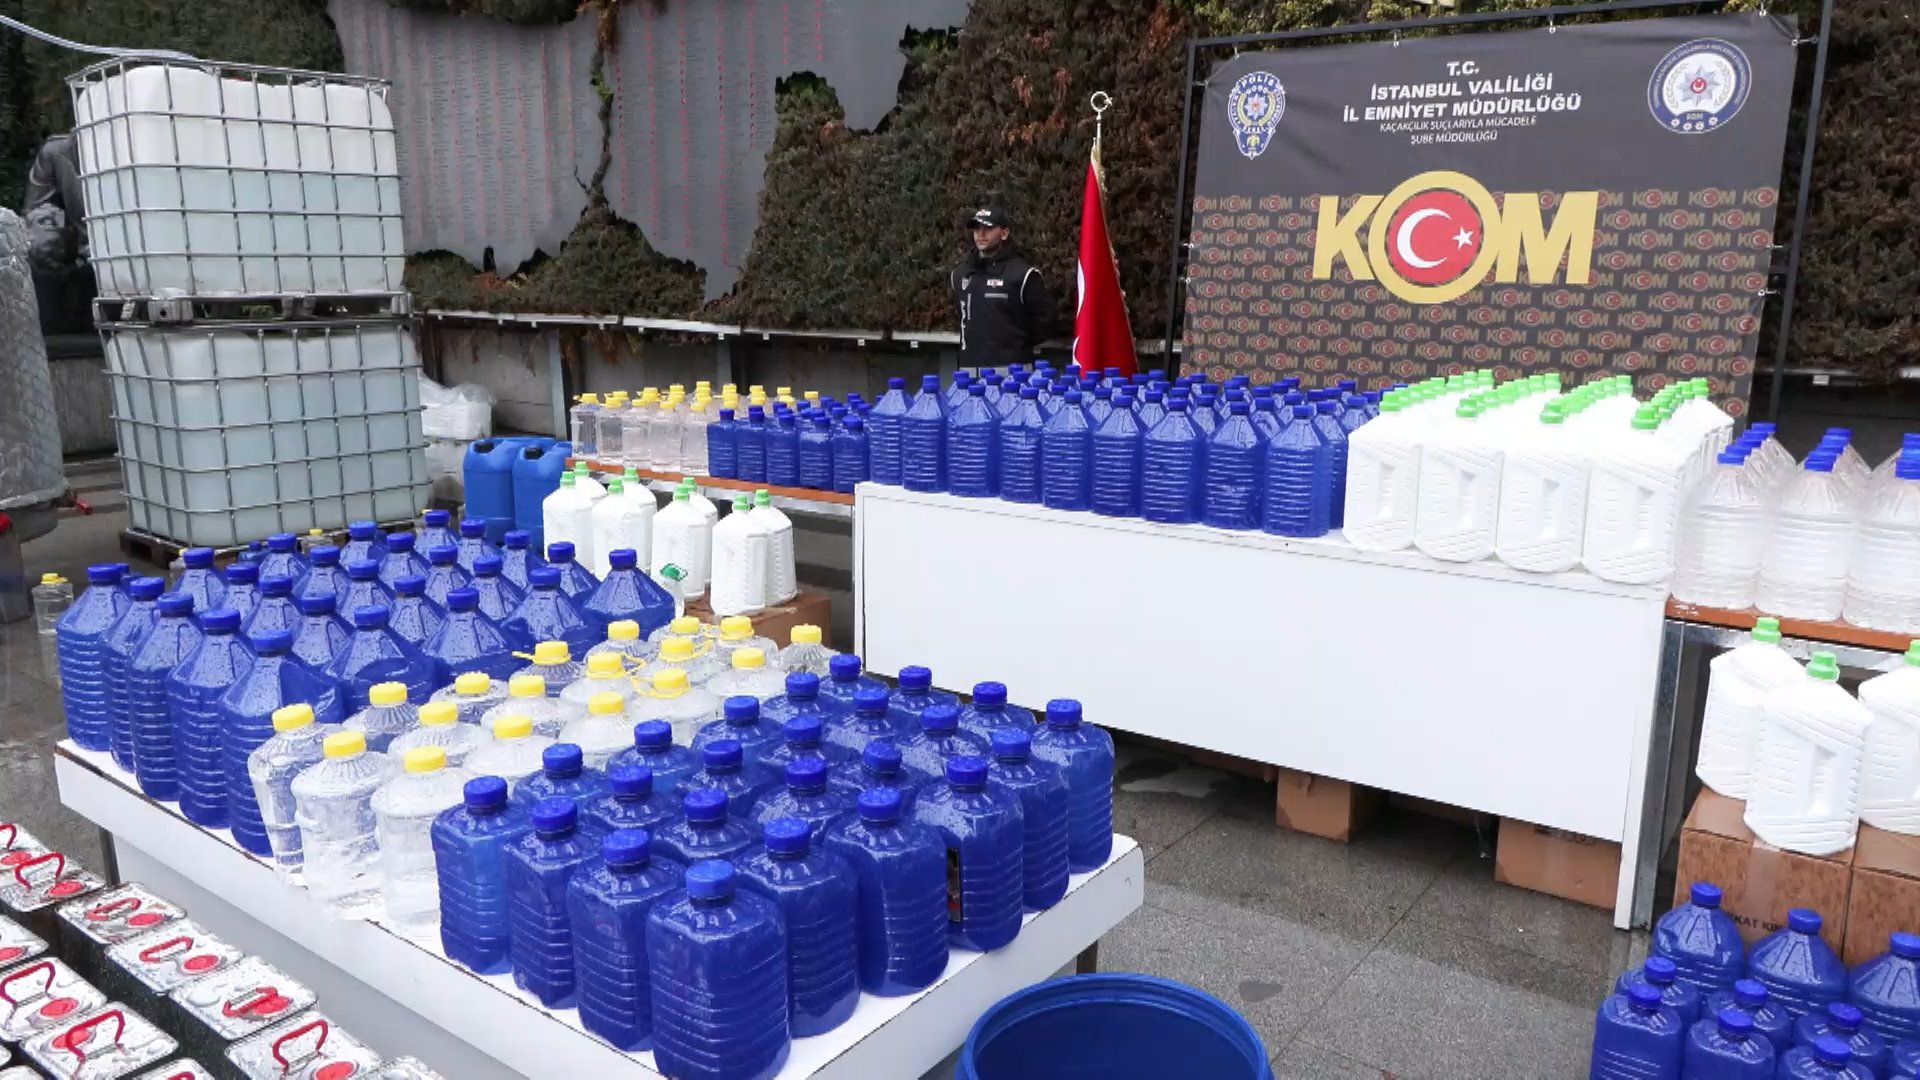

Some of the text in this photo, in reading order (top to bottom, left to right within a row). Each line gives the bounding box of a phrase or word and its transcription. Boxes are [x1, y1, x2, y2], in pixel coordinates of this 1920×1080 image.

[1446, 61, 1480, 76] T.C.
[1371, 72, 1553, 100] İSTANBUL VALİLİĞİ
[1344, 93, 1581, 122] İL EMNİYET MÜDÜRLÜĞÜ
[1380, 115, 1537, 134] KAÇAKÇILIK SUÇLARIYLA MÜCADELE
[1312, 171, 1599, 304] KOM
